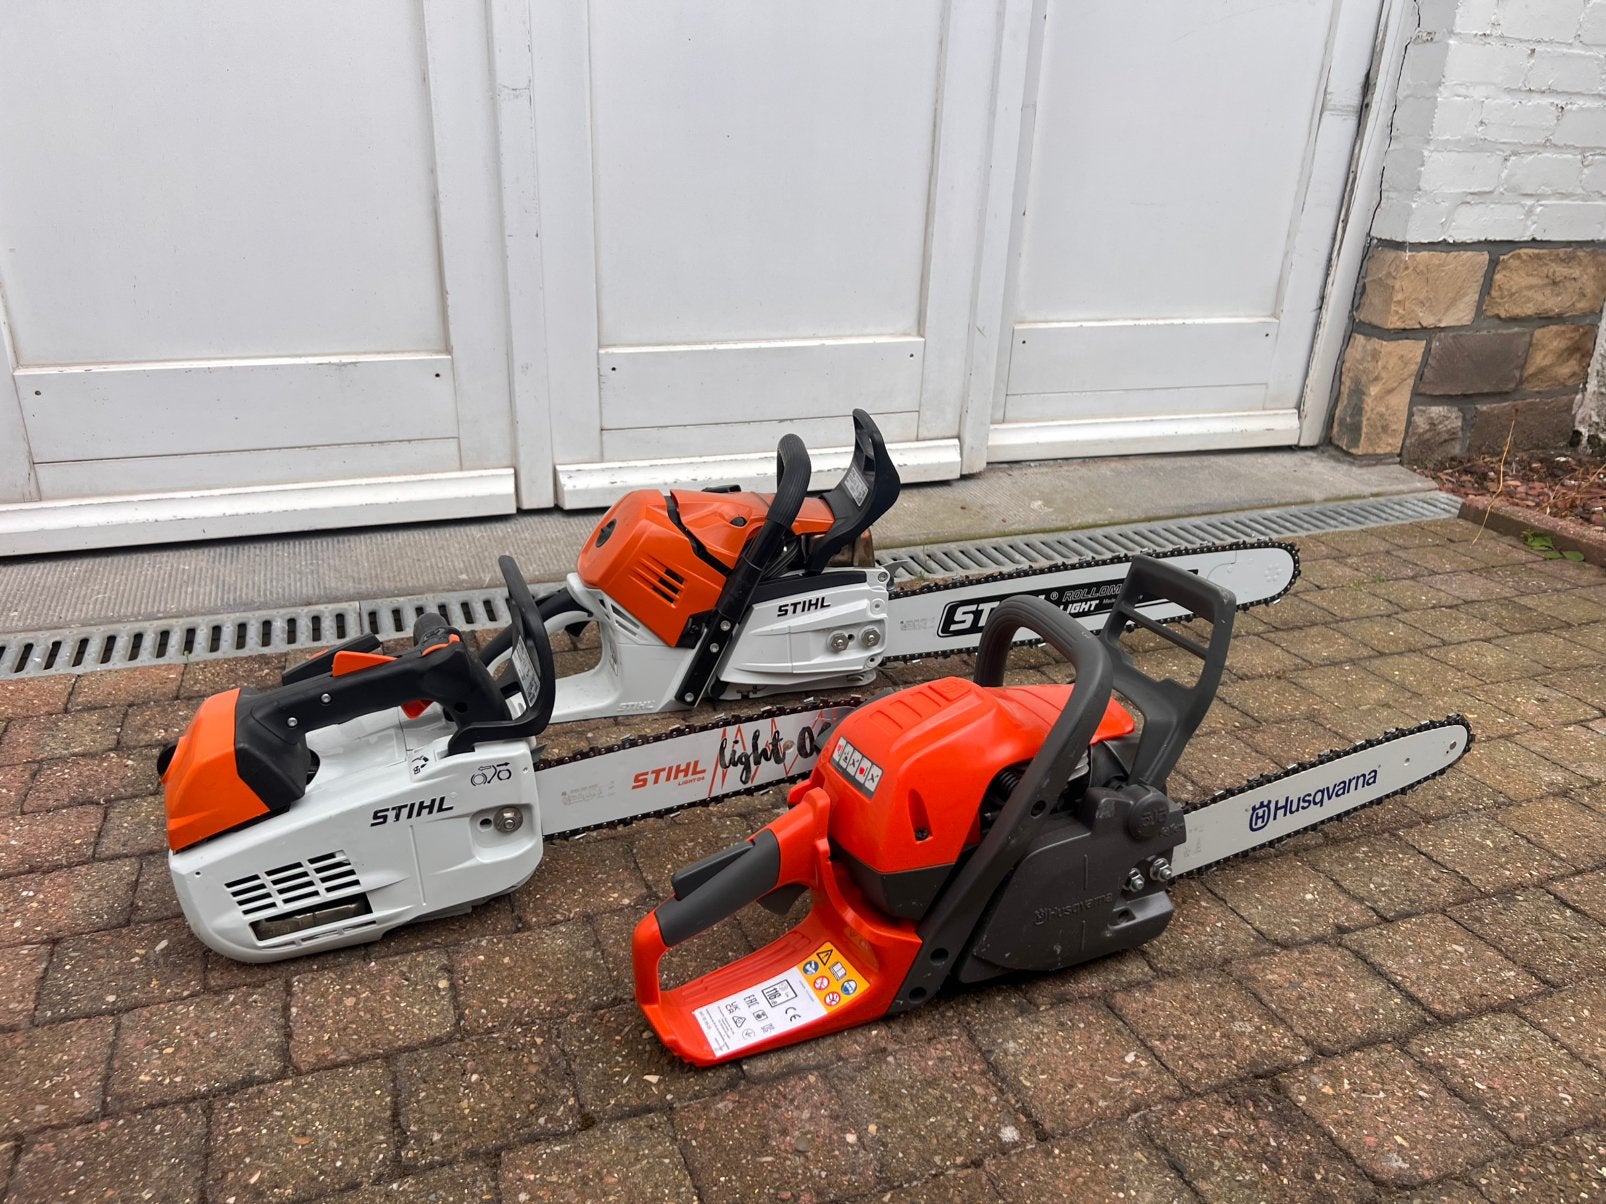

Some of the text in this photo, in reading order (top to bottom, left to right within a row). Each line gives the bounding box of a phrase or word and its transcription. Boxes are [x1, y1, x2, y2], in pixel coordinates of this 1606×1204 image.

[777, 596, 831, 617] STIHL
[1062, 584, 1123, 602] ROLLOM
[719, 729, 786, 785] light
[632, 760, 706, 790] STIHL
[1273, 769, 1378, 820] Husqvarna
[370, 796, 454, 827] STIHL
